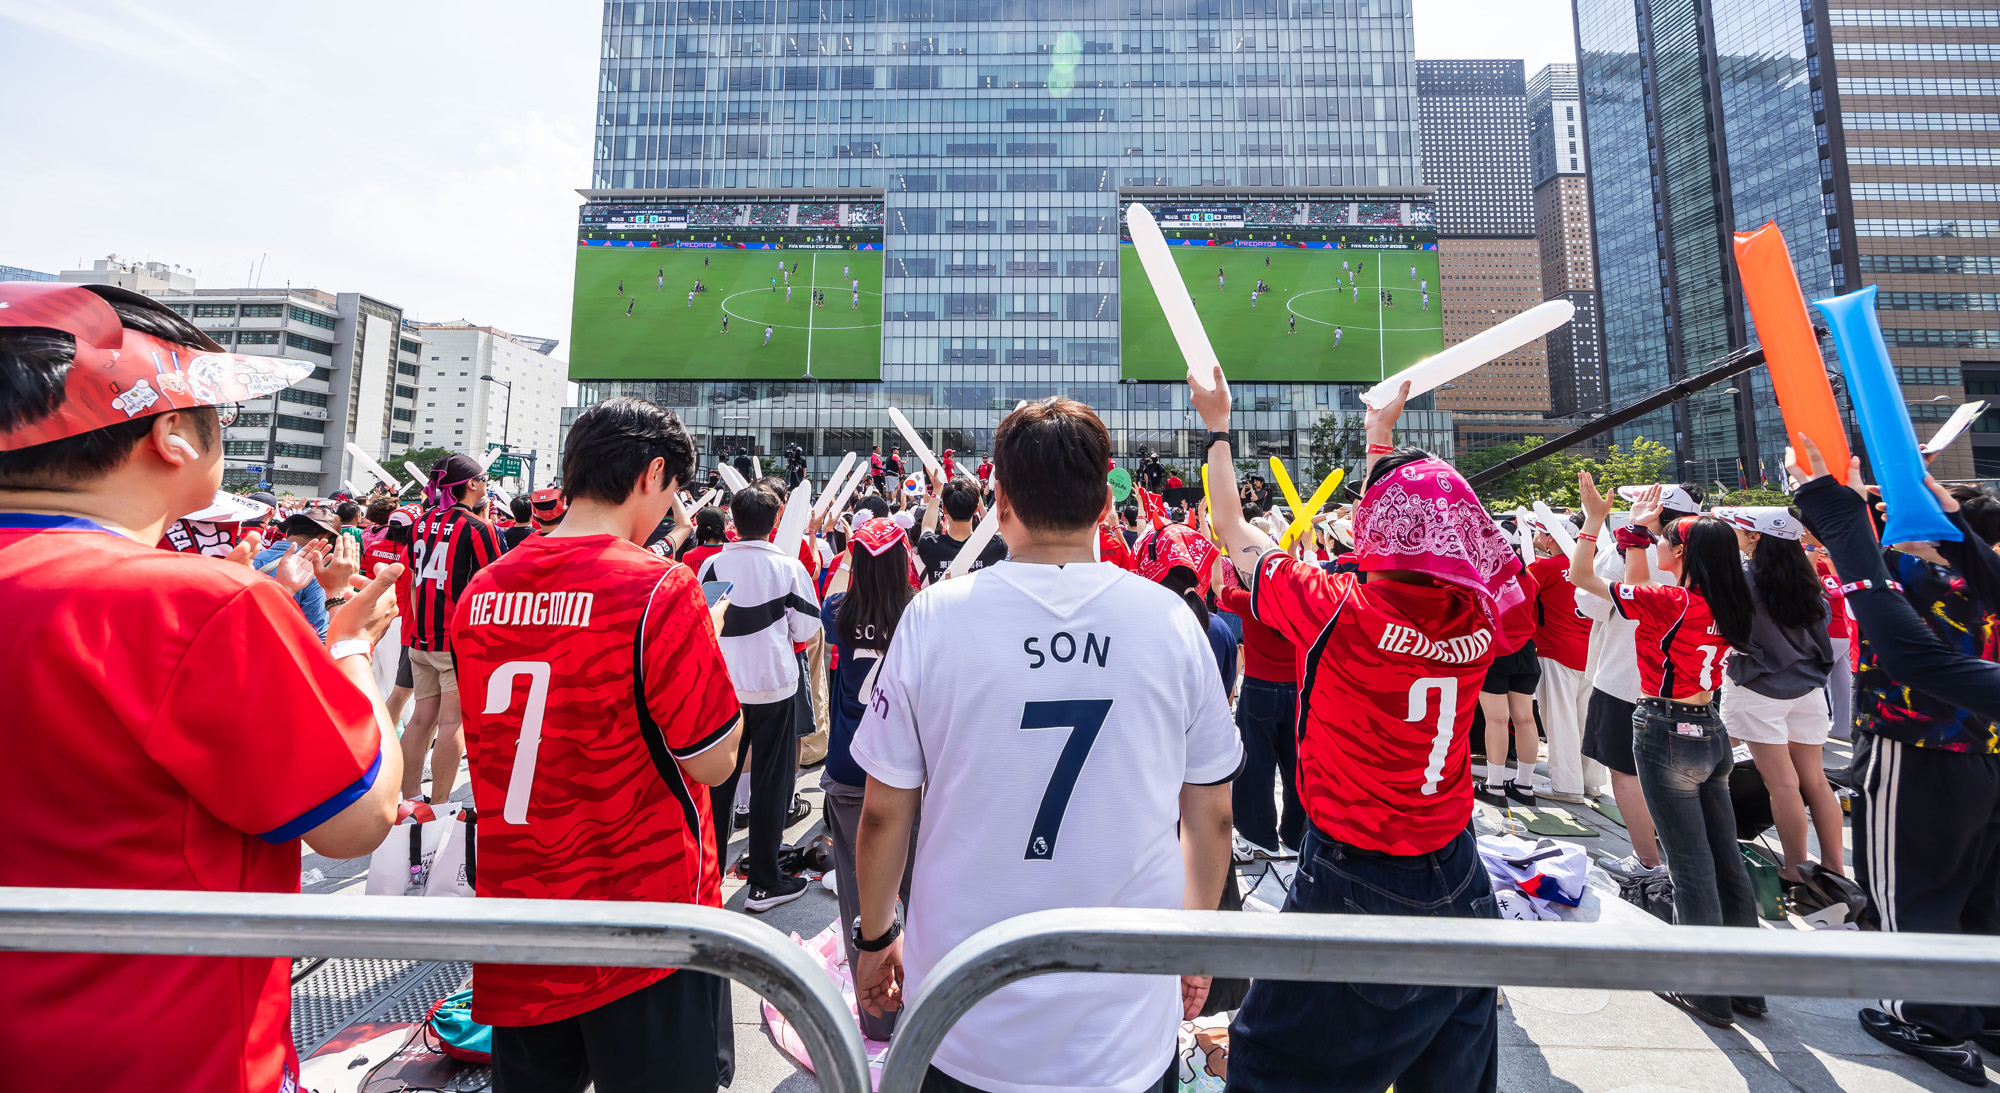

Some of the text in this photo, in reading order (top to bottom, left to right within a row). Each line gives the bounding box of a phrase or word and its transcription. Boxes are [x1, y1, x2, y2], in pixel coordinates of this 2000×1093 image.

[166, 520, 193, 552] REA
[413, 538, 450, 590] 34
[469, 591, 595, 628] HEUNGMIN
[853, 648, 885, 705] 7
[1023, 631, 1111, 669] SON
[481, 660, 551, 825] 7
[1403, 676, 1458, 796] 7
[1018, 698, 1115, 861] 7
